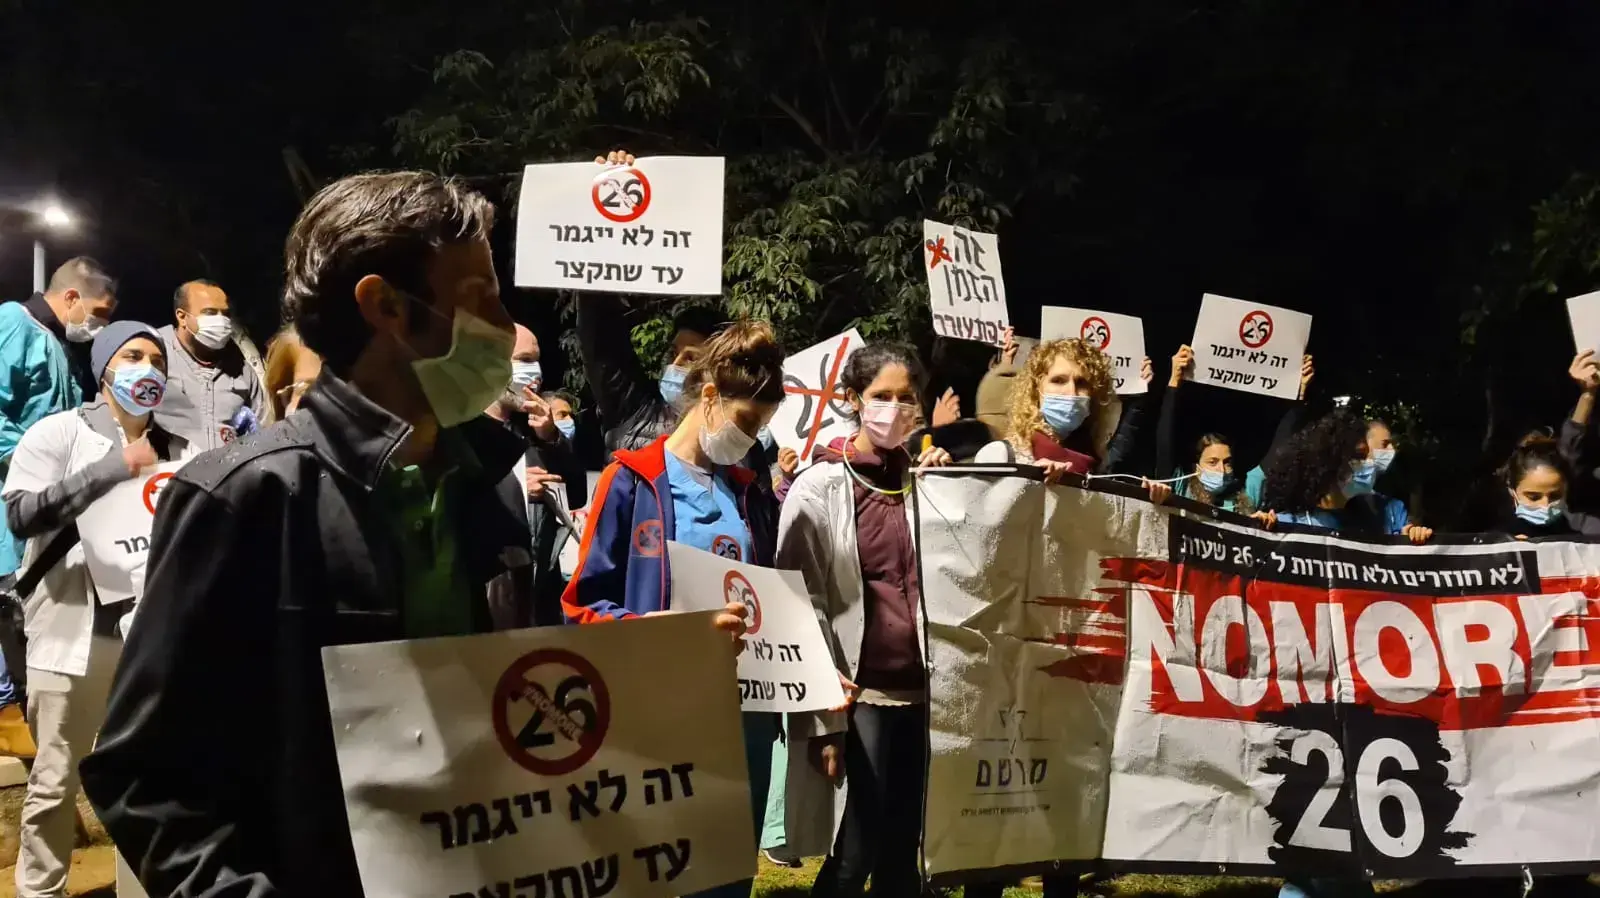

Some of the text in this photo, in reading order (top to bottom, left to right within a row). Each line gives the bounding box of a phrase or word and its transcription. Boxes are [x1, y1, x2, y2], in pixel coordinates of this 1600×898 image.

[601, 179, 643, 209] 26
[549, 224, 692, 248] זה לא ייגמר
[953, 230, 986, 271] זה
[555, 260, 684, 285] עד שתקצר
[944, 264, 998, 306] הזמן
[1115, 356, 1131, 367] זה
[1210, 344, 1288, 368] זה לא ייגמר
[1208, 367, 1278, 390] עד שתקצר
[1232, 546, 1254, 567] 26
[1291, 556, 1358, 582] חוזרות
[1362, 564, 1400, 587] ולא
[1402, 568, 1482, 588] חוזרים
[1489, 563, 1524, 586] לא
[753, 639, 773, 662] לא
[778, 644, 802, 662] זה
[1128, 588, 1600, 707] NOMORE
[737, 678, 806, 705] עד שתק
[508, 675, 597, 748] 26
[1287, 727, 1426, 859] 26
[420, 763, 694, 851] זה לא ייגמר
[449, 838, 691, 898] עד שתקצ
